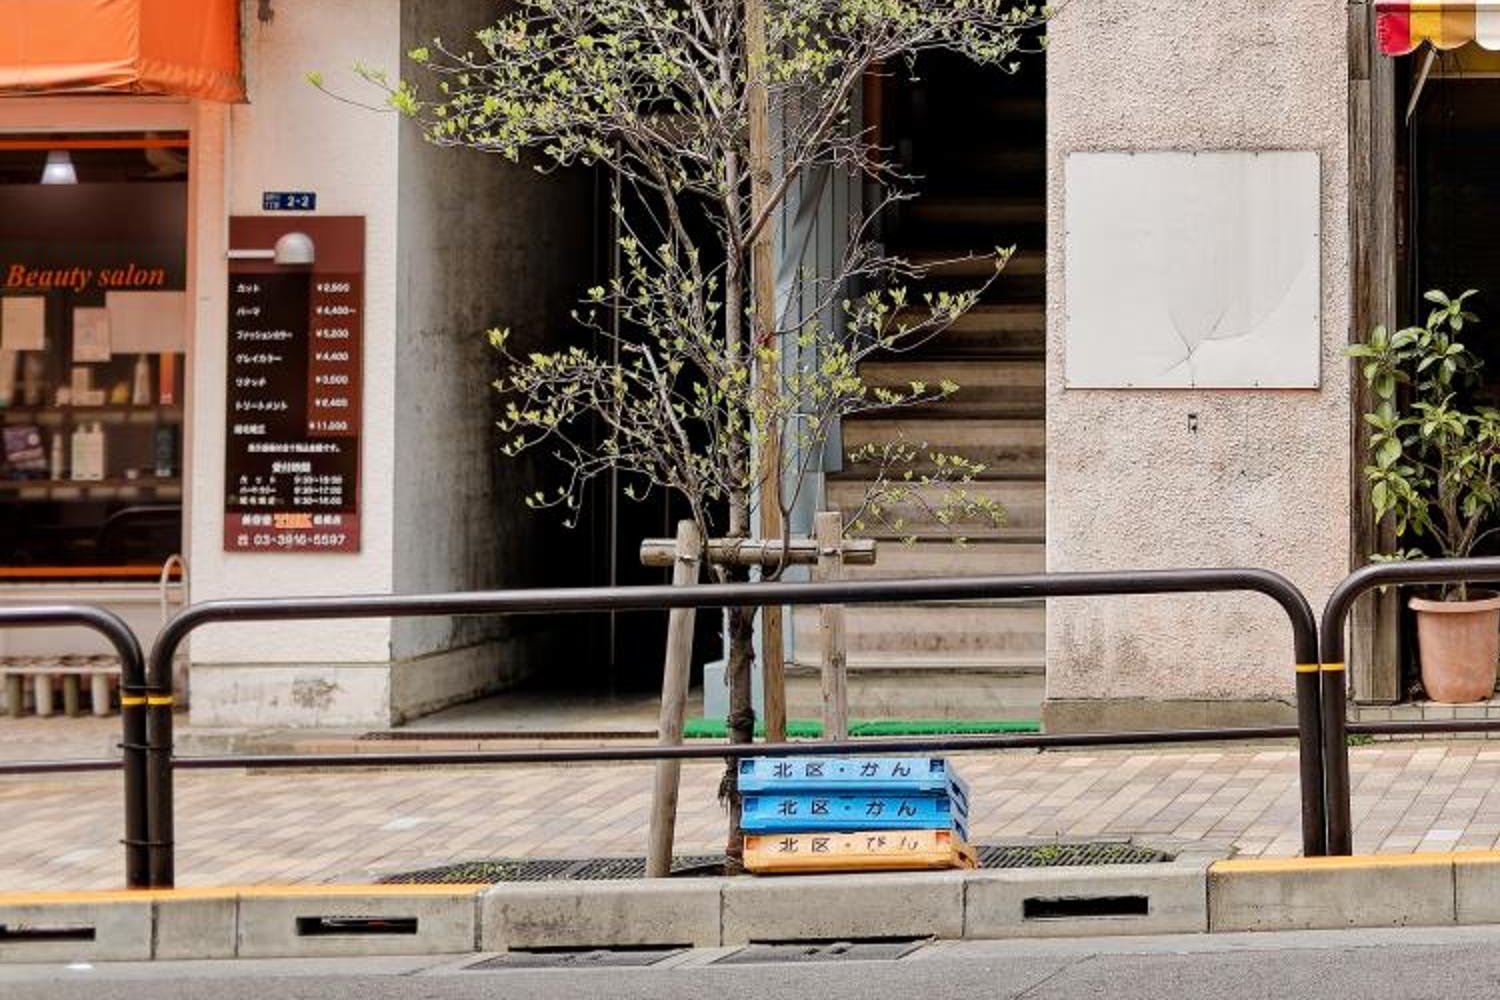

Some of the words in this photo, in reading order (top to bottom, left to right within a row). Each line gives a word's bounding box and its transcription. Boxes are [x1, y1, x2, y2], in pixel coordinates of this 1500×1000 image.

[6, 264, 93, 292] Beauty
[99, 263, 165, 288] salon
[236, 283, 261, 293] カット
[773, 762, 912, 778] 北区・かん
[778, 800, 918, 816] 北区・かん
